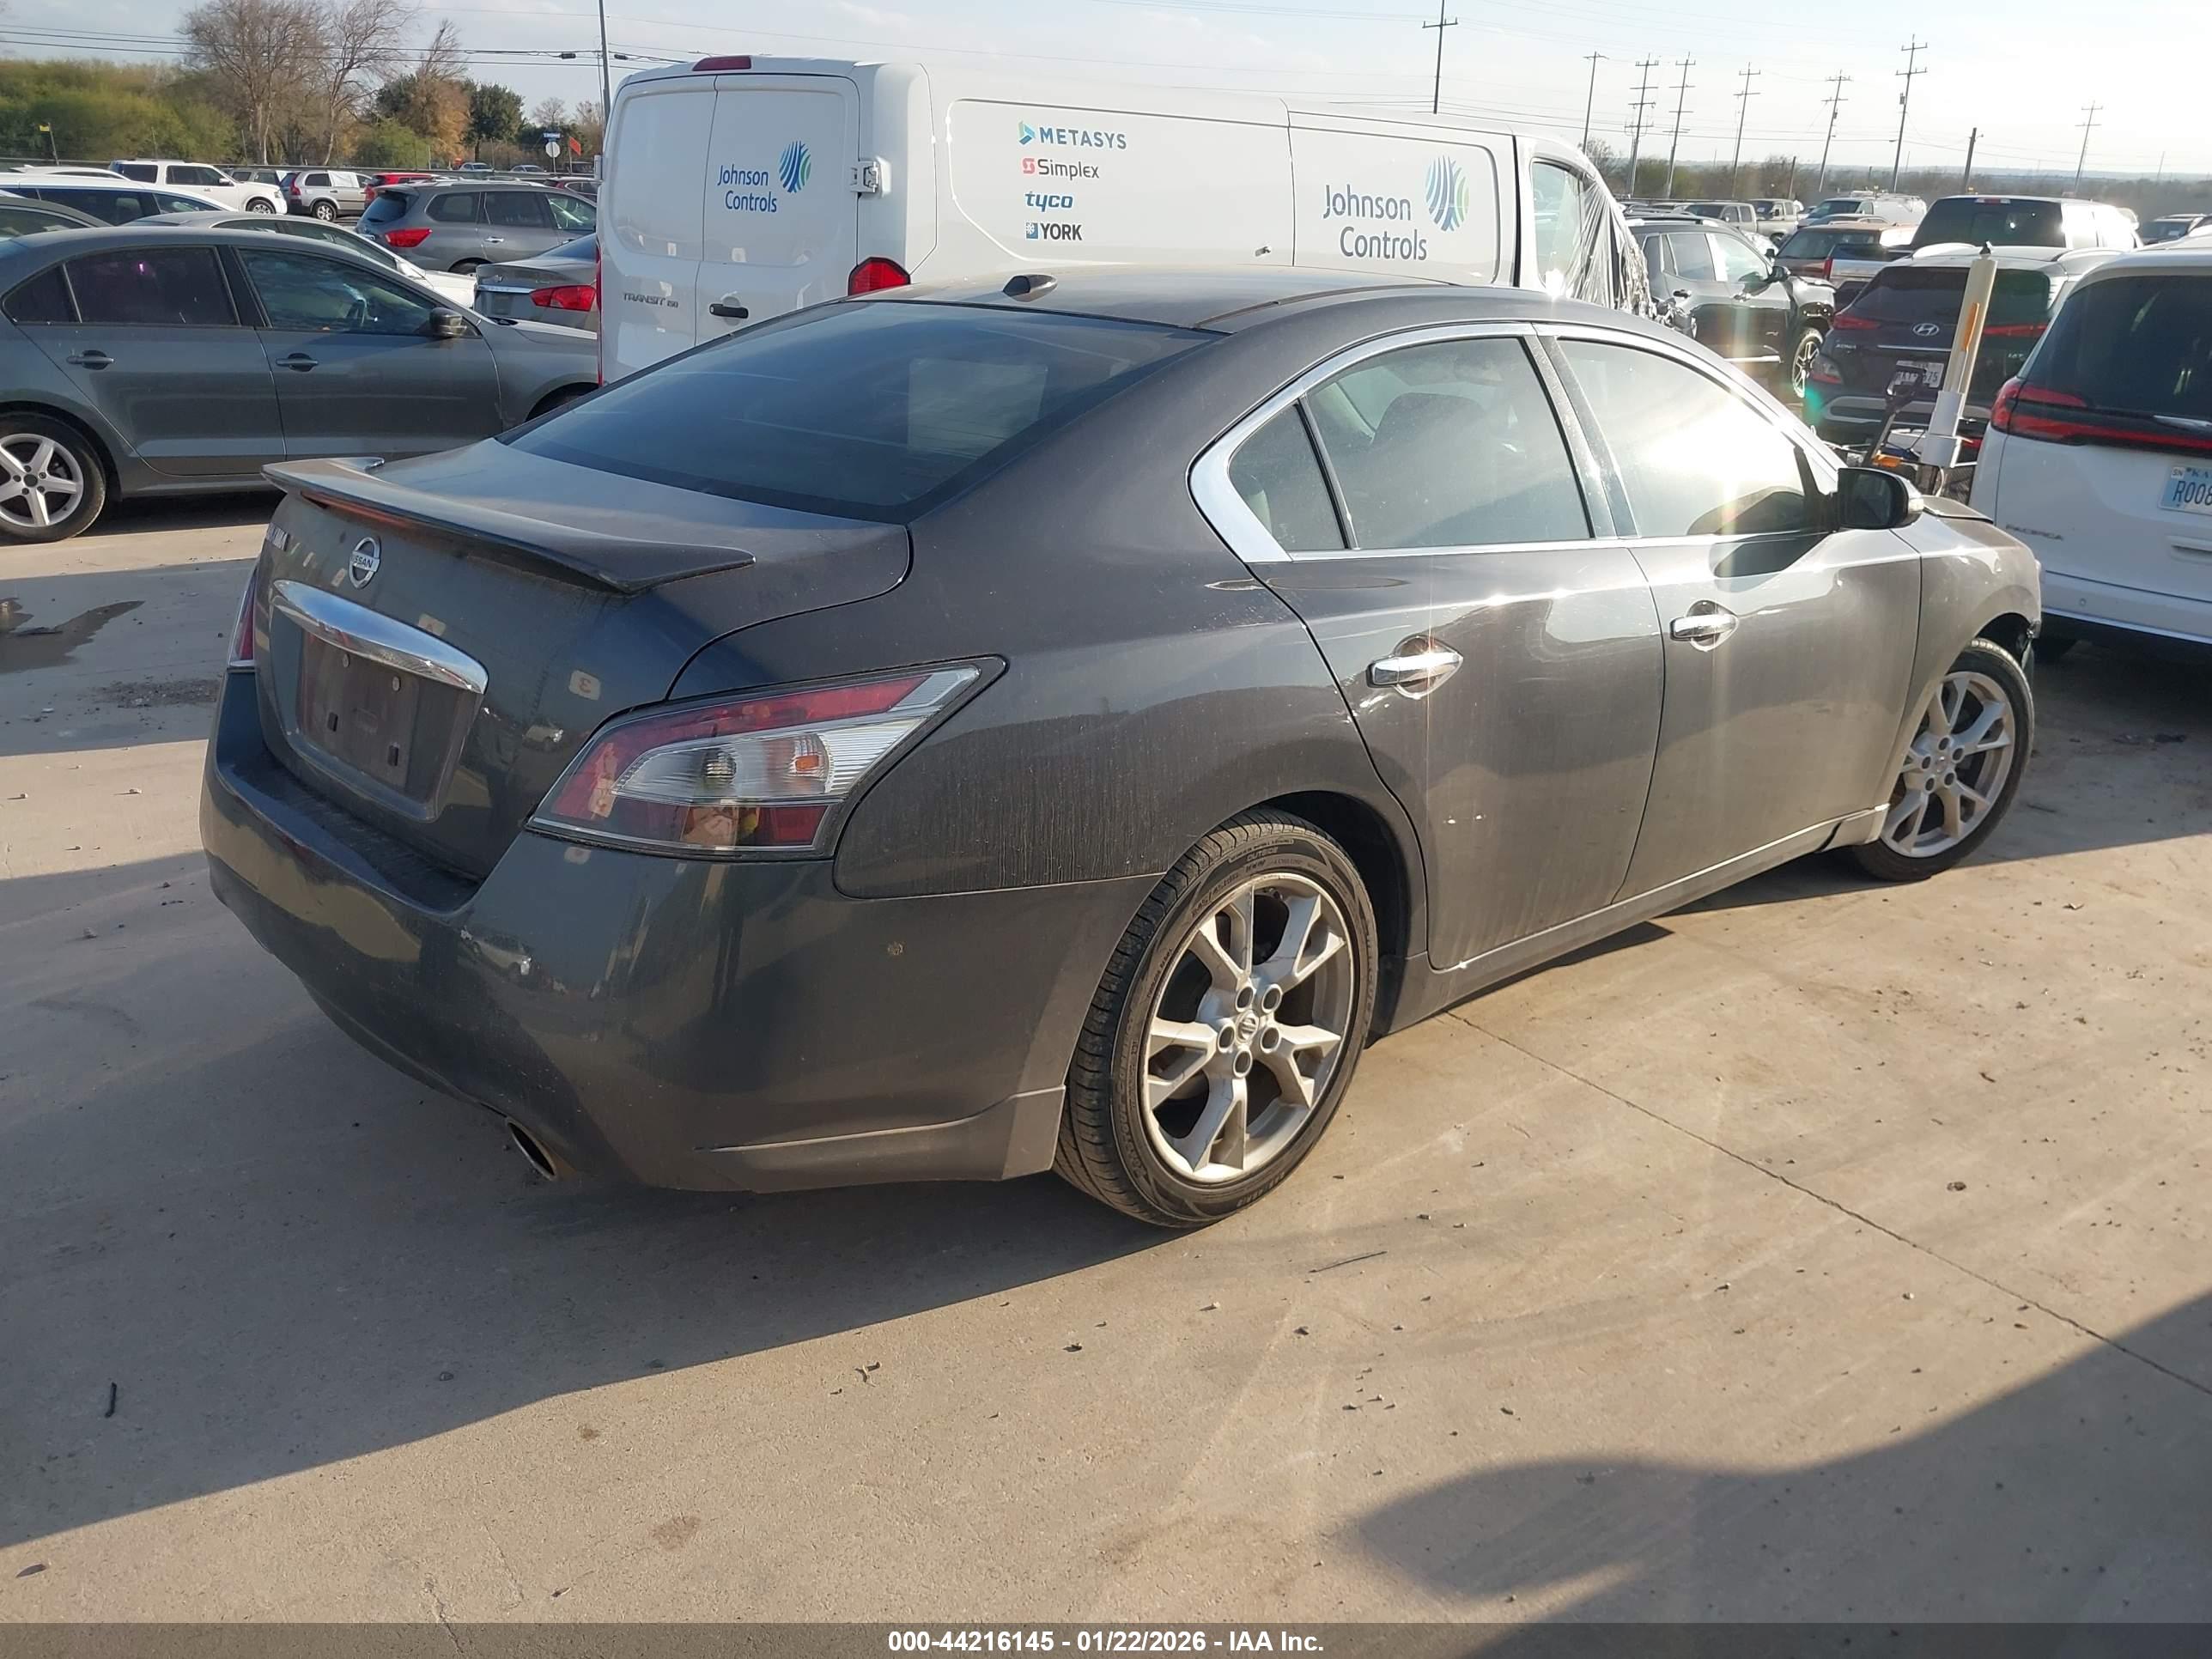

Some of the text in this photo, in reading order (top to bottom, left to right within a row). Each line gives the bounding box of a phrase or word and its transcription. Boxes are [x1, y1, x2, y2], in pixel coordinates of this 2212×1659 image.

[1039, 126, 1127, 149] METASYS
[717, 163, 769, 186] Johnson
[1037, 158, 1099, 180] Simplex
[725, 190, 777, 213] Controls
[1024, 191, 1073, 212] tyco
[1323, 184, 1411, 221] Johnson
[1040, 222, 1083, 240] YORK
[1340, 226, 1427, 261] Controls
[623, 293, 665, 306] TRANSIT
